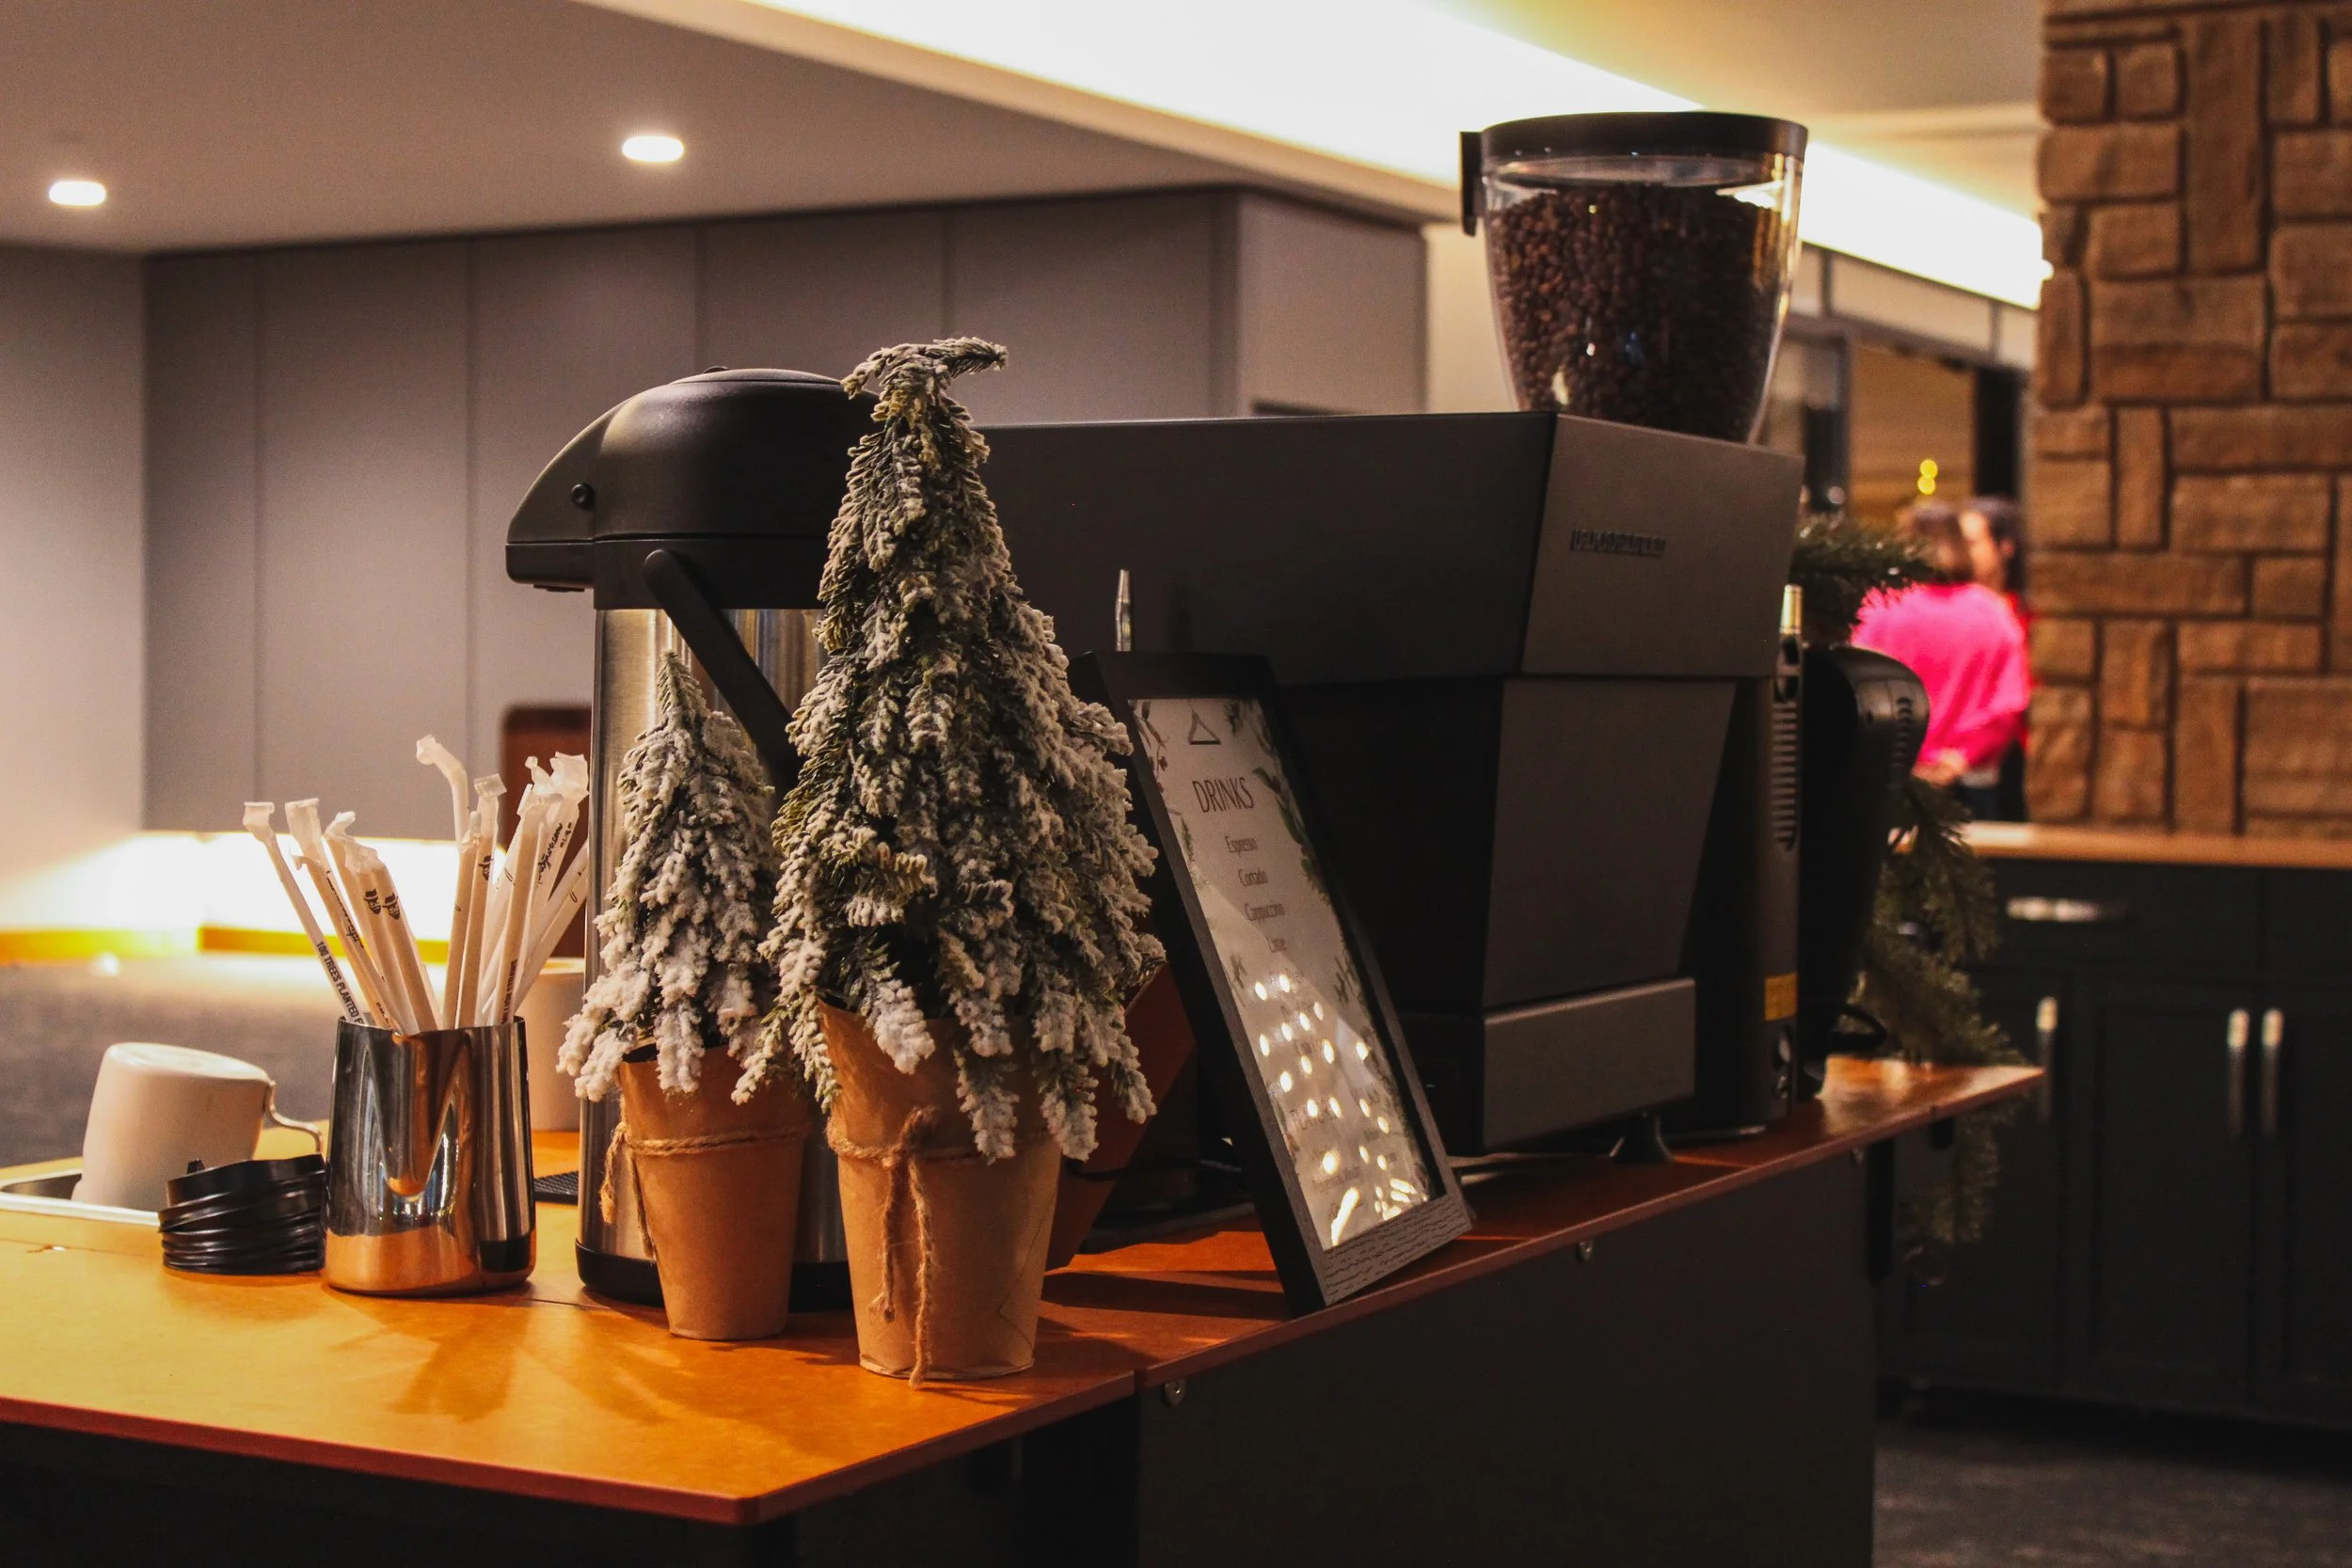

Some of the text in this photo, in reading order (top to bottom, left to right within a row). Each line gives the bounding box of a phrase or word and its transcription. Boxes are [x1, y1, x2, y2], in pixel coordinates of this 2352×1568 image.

[1192, 777, 1254, 813] DRINKS
[1225, 835, 1258, 857] Espresso
[1238, 865, 1268, 887] Cortado
[1245, 900, 1285, 925] Cappuccino
[316, 941, 329, 957] 100
[324, 955, 342, 983] TREES
[336, 981, 360, 1018] PLANTED
